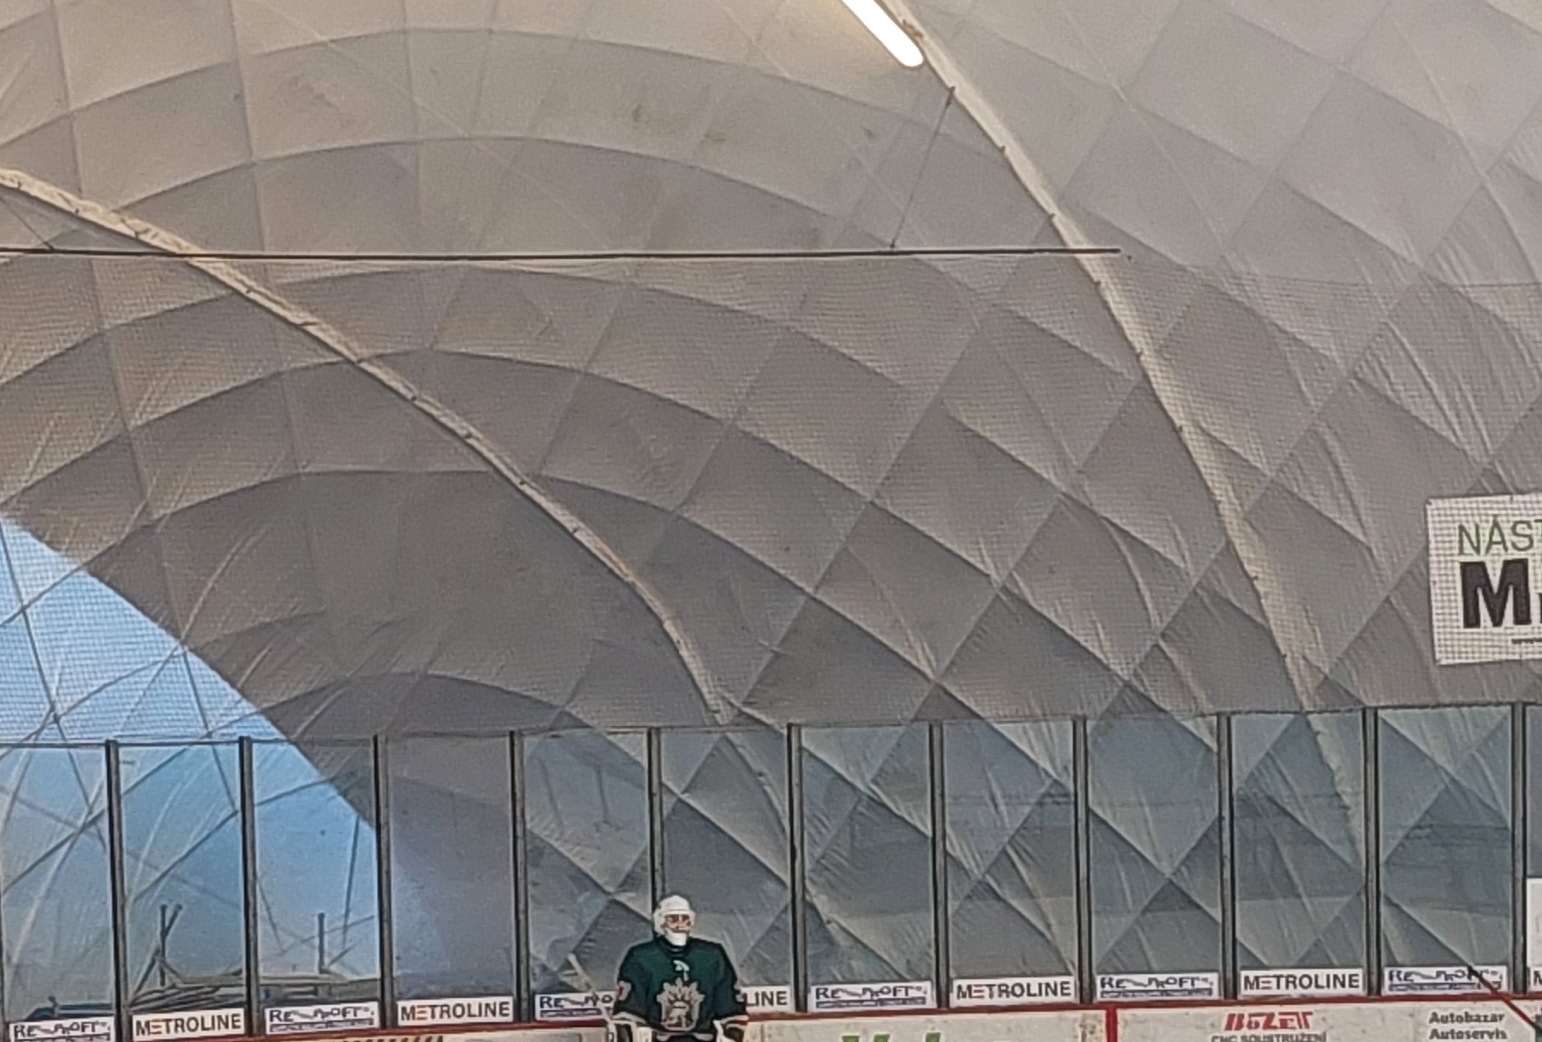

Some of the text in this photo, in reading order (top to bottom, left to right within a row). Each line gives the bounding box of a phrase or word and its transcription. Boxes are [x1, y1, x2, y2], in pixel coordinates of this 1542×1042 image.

[957, 980, 1071, 1000] METROLINE
[1244, 973, 1360, 991] METROLINE
[400, 1001, 511, 1023] METROLINE
[1429, 1011, 1505, 1024] Autobazar
[136, 1012, 242, 1036] METROLINE
[1429, 1028, 1507, 1041] Autoservis
